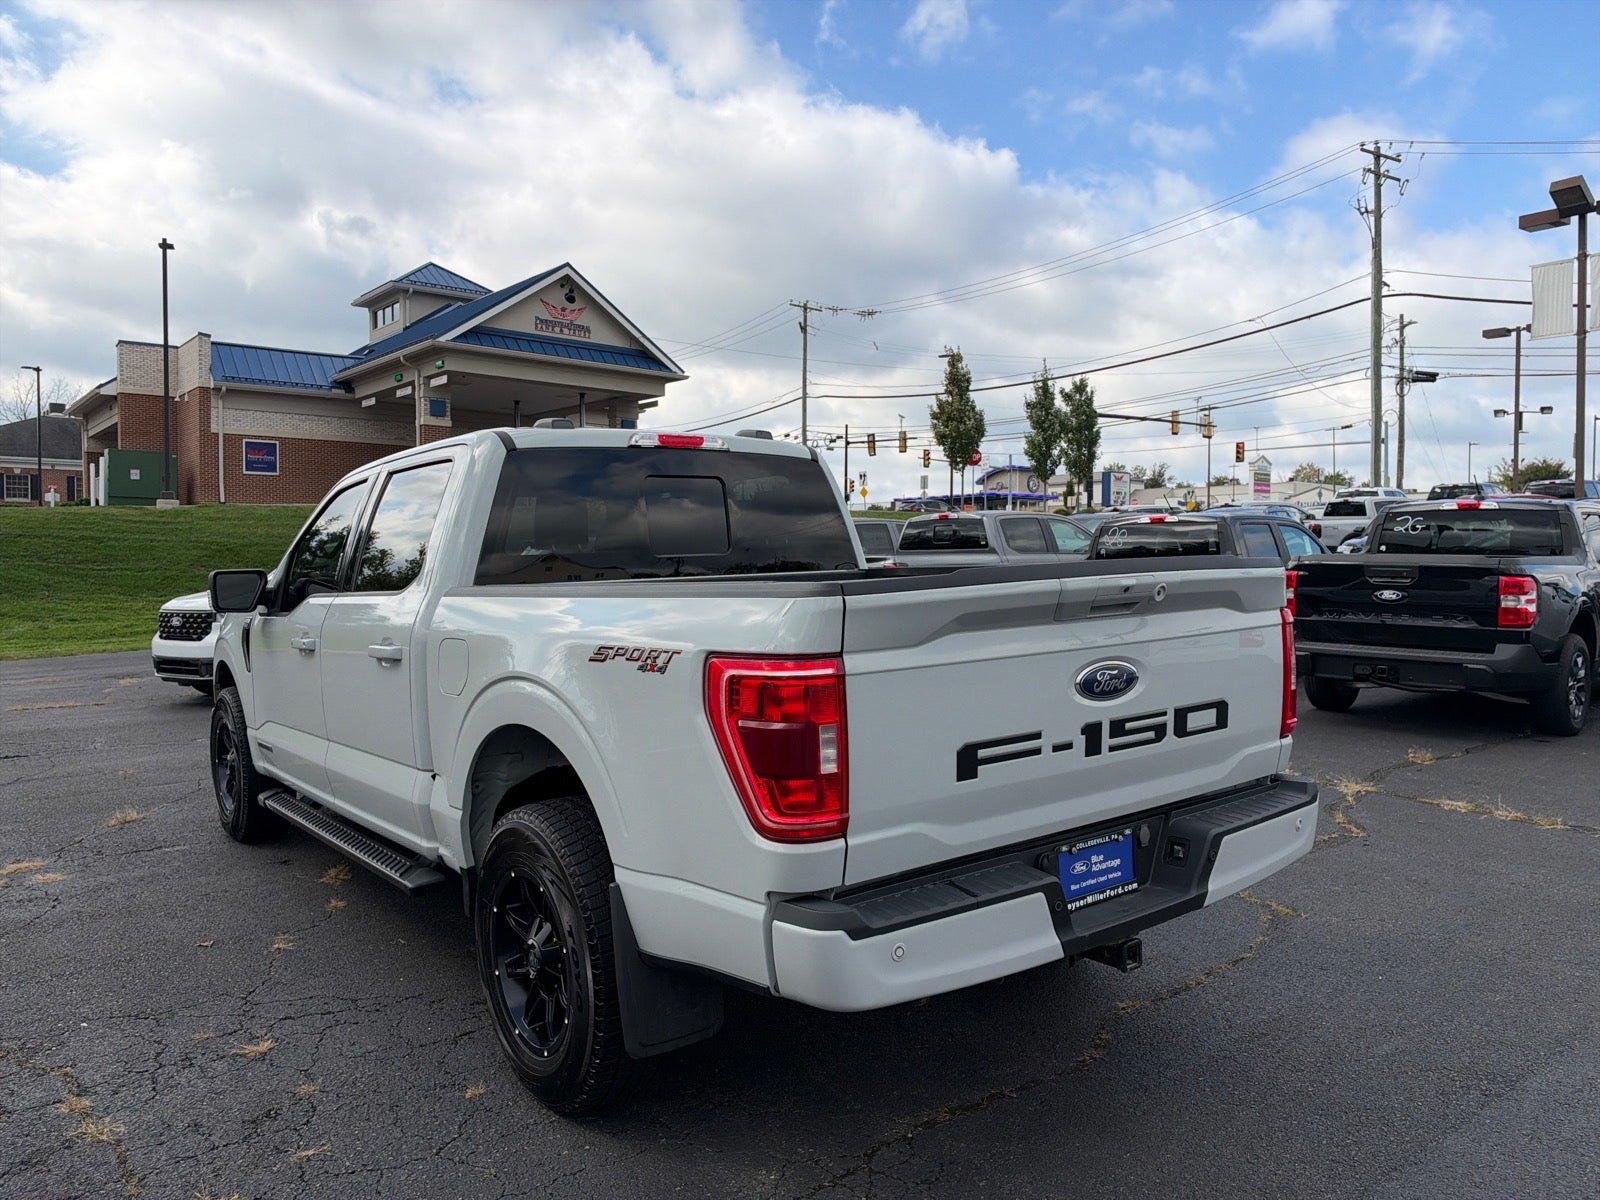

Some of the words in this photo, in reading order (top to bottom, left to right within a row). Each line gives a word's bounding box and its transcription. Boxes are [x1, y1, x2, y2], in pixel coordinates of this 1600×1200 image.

[1322, 611, 1466, 625] MAVERCK
[588, 644, 682, 665] SPORT
[1093, 669, 1127, 693] Ford
[956, 697, 1229, 783] F-150
[1091, 854, 1104, 863] Blue
[1091, 858, 1121, 872] Advantage
